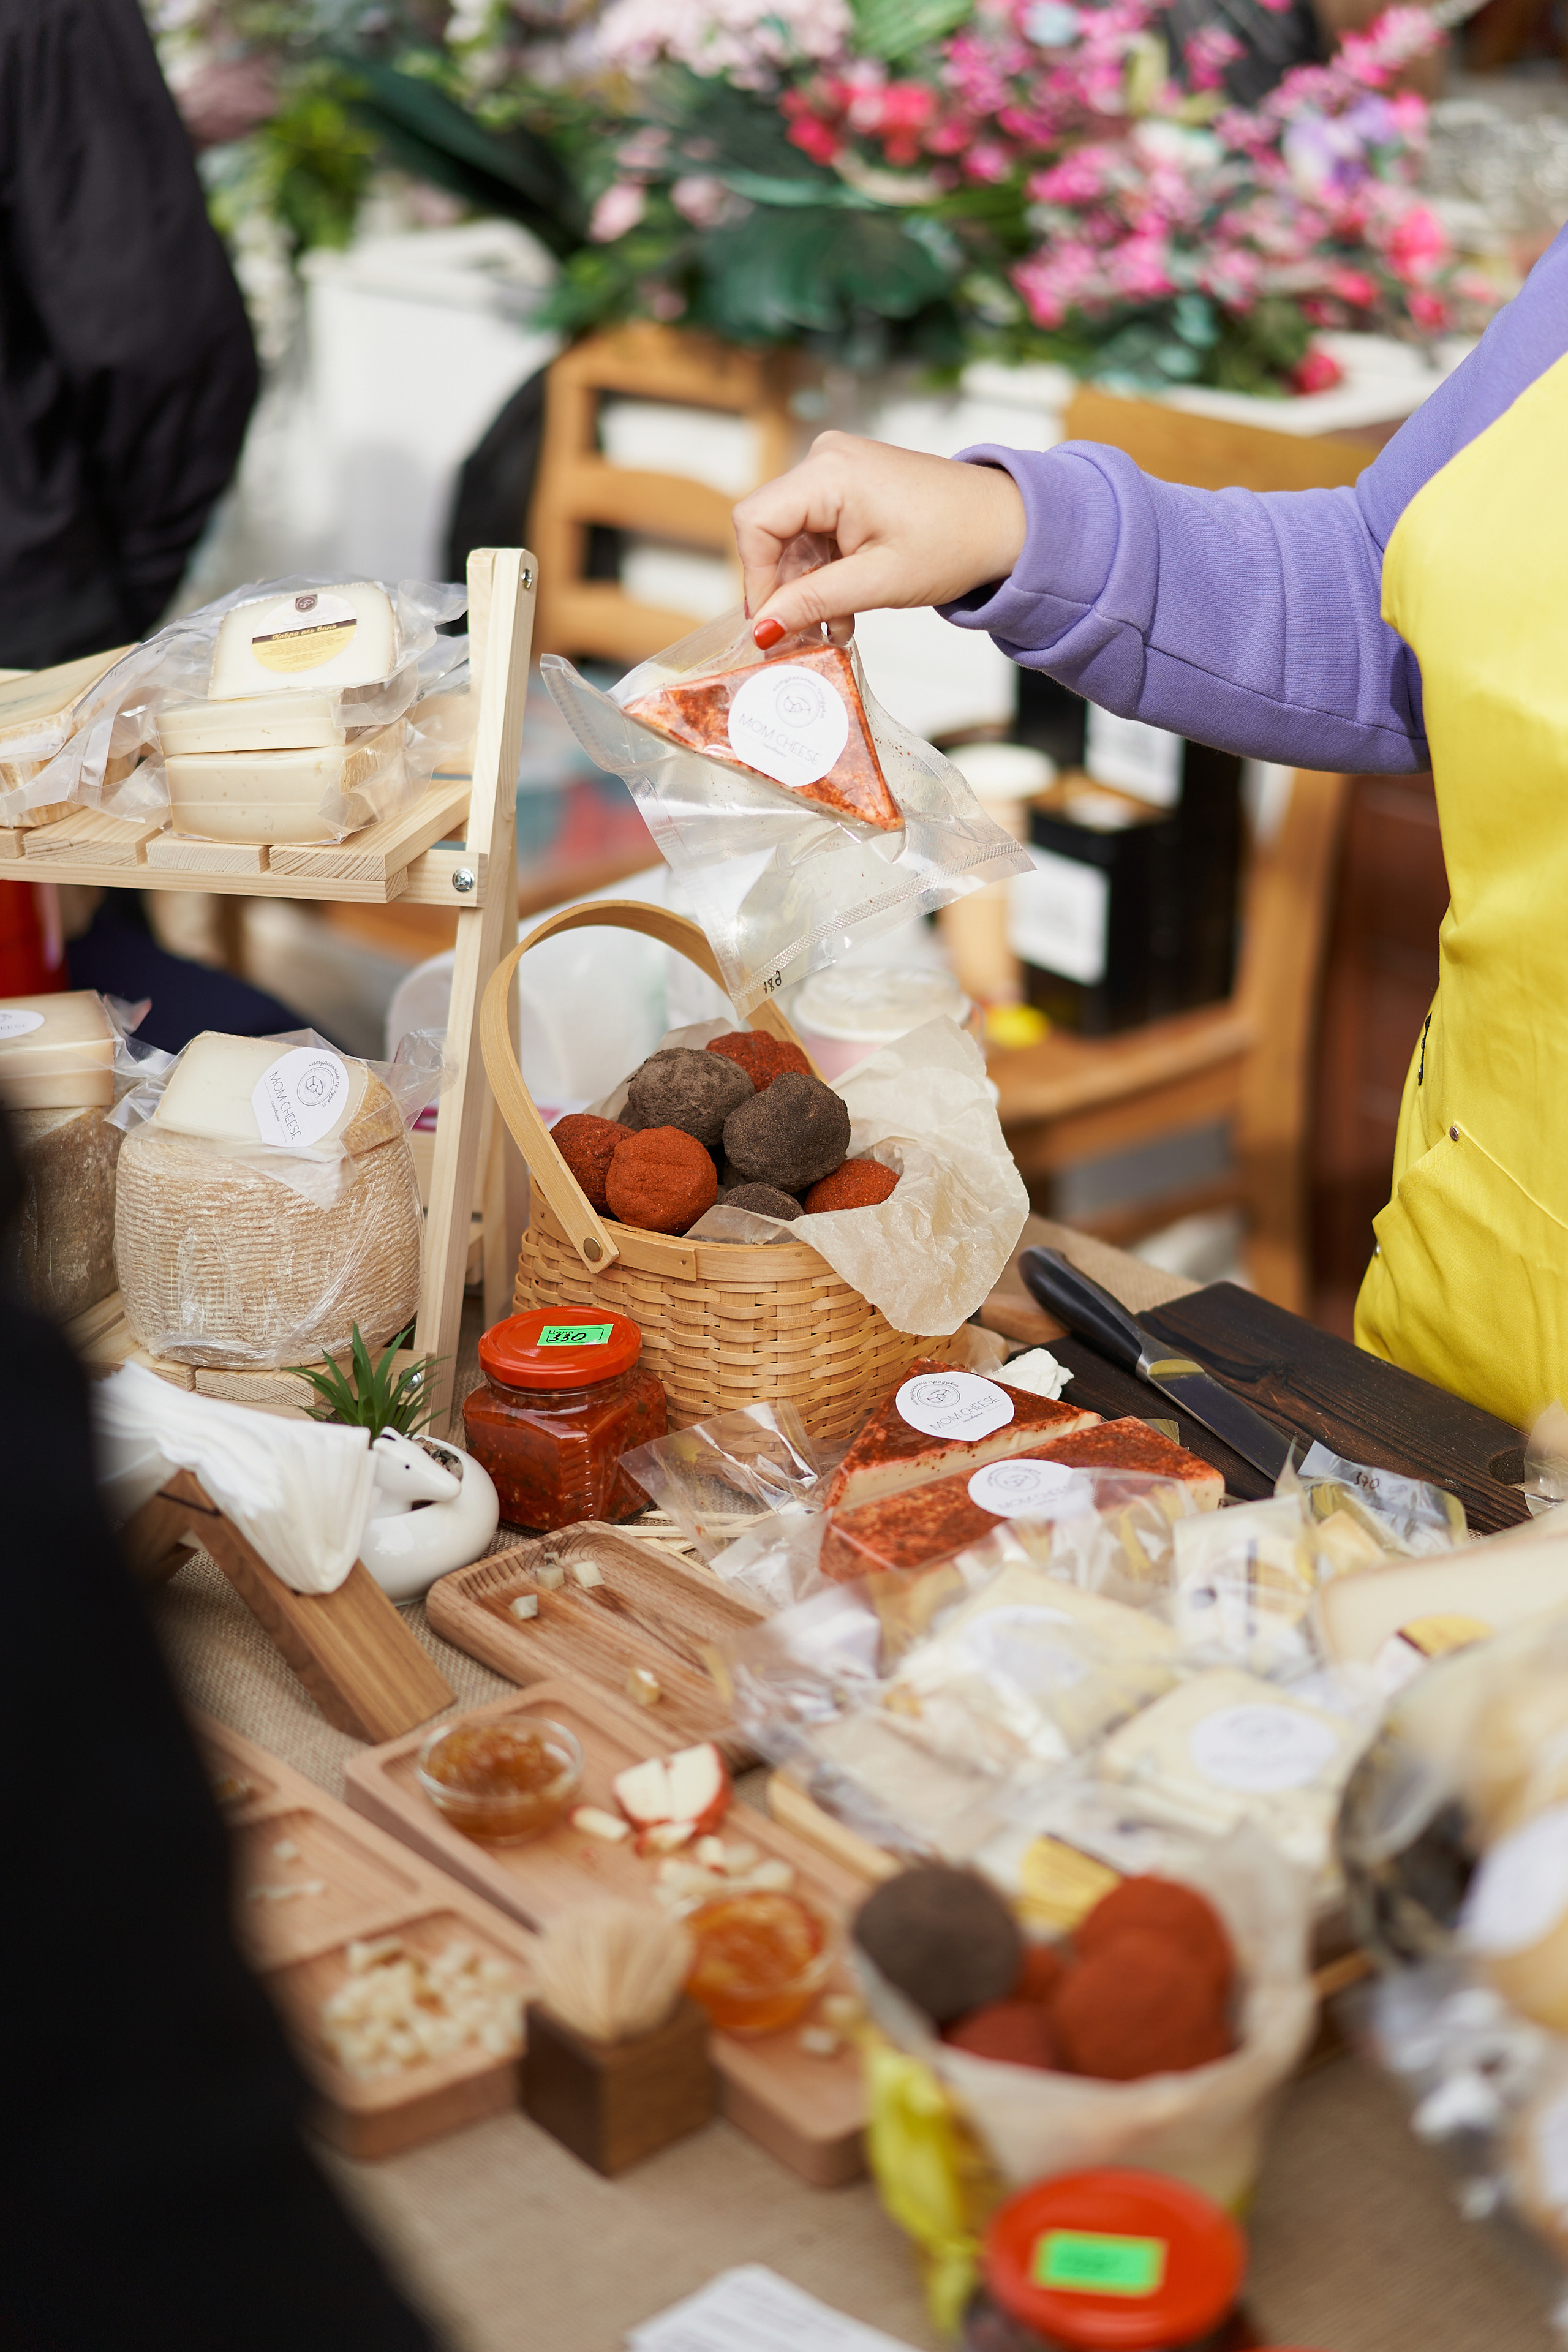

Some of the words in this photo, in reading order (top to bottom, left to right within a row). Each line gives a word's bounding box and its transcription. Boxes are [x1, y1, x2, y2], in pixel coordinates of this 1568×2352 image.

[272, 632, 300, 641] Кабра
[739, 713, 775, 740] MOM
[776, 734, 823, 766] CHEESE
[308, 1060, 341, 1080] натуральный
[270, 1071, 287, 1102] MOM
[281, 1101, 302, 1140] CHEESE
[322, 1081, 340, 1108] продукт
[548, 1332, 587, 1342] 330
[929, 1412, 962, 1430] MOM
[960, 1395, 1000, 1415] CHEESE
